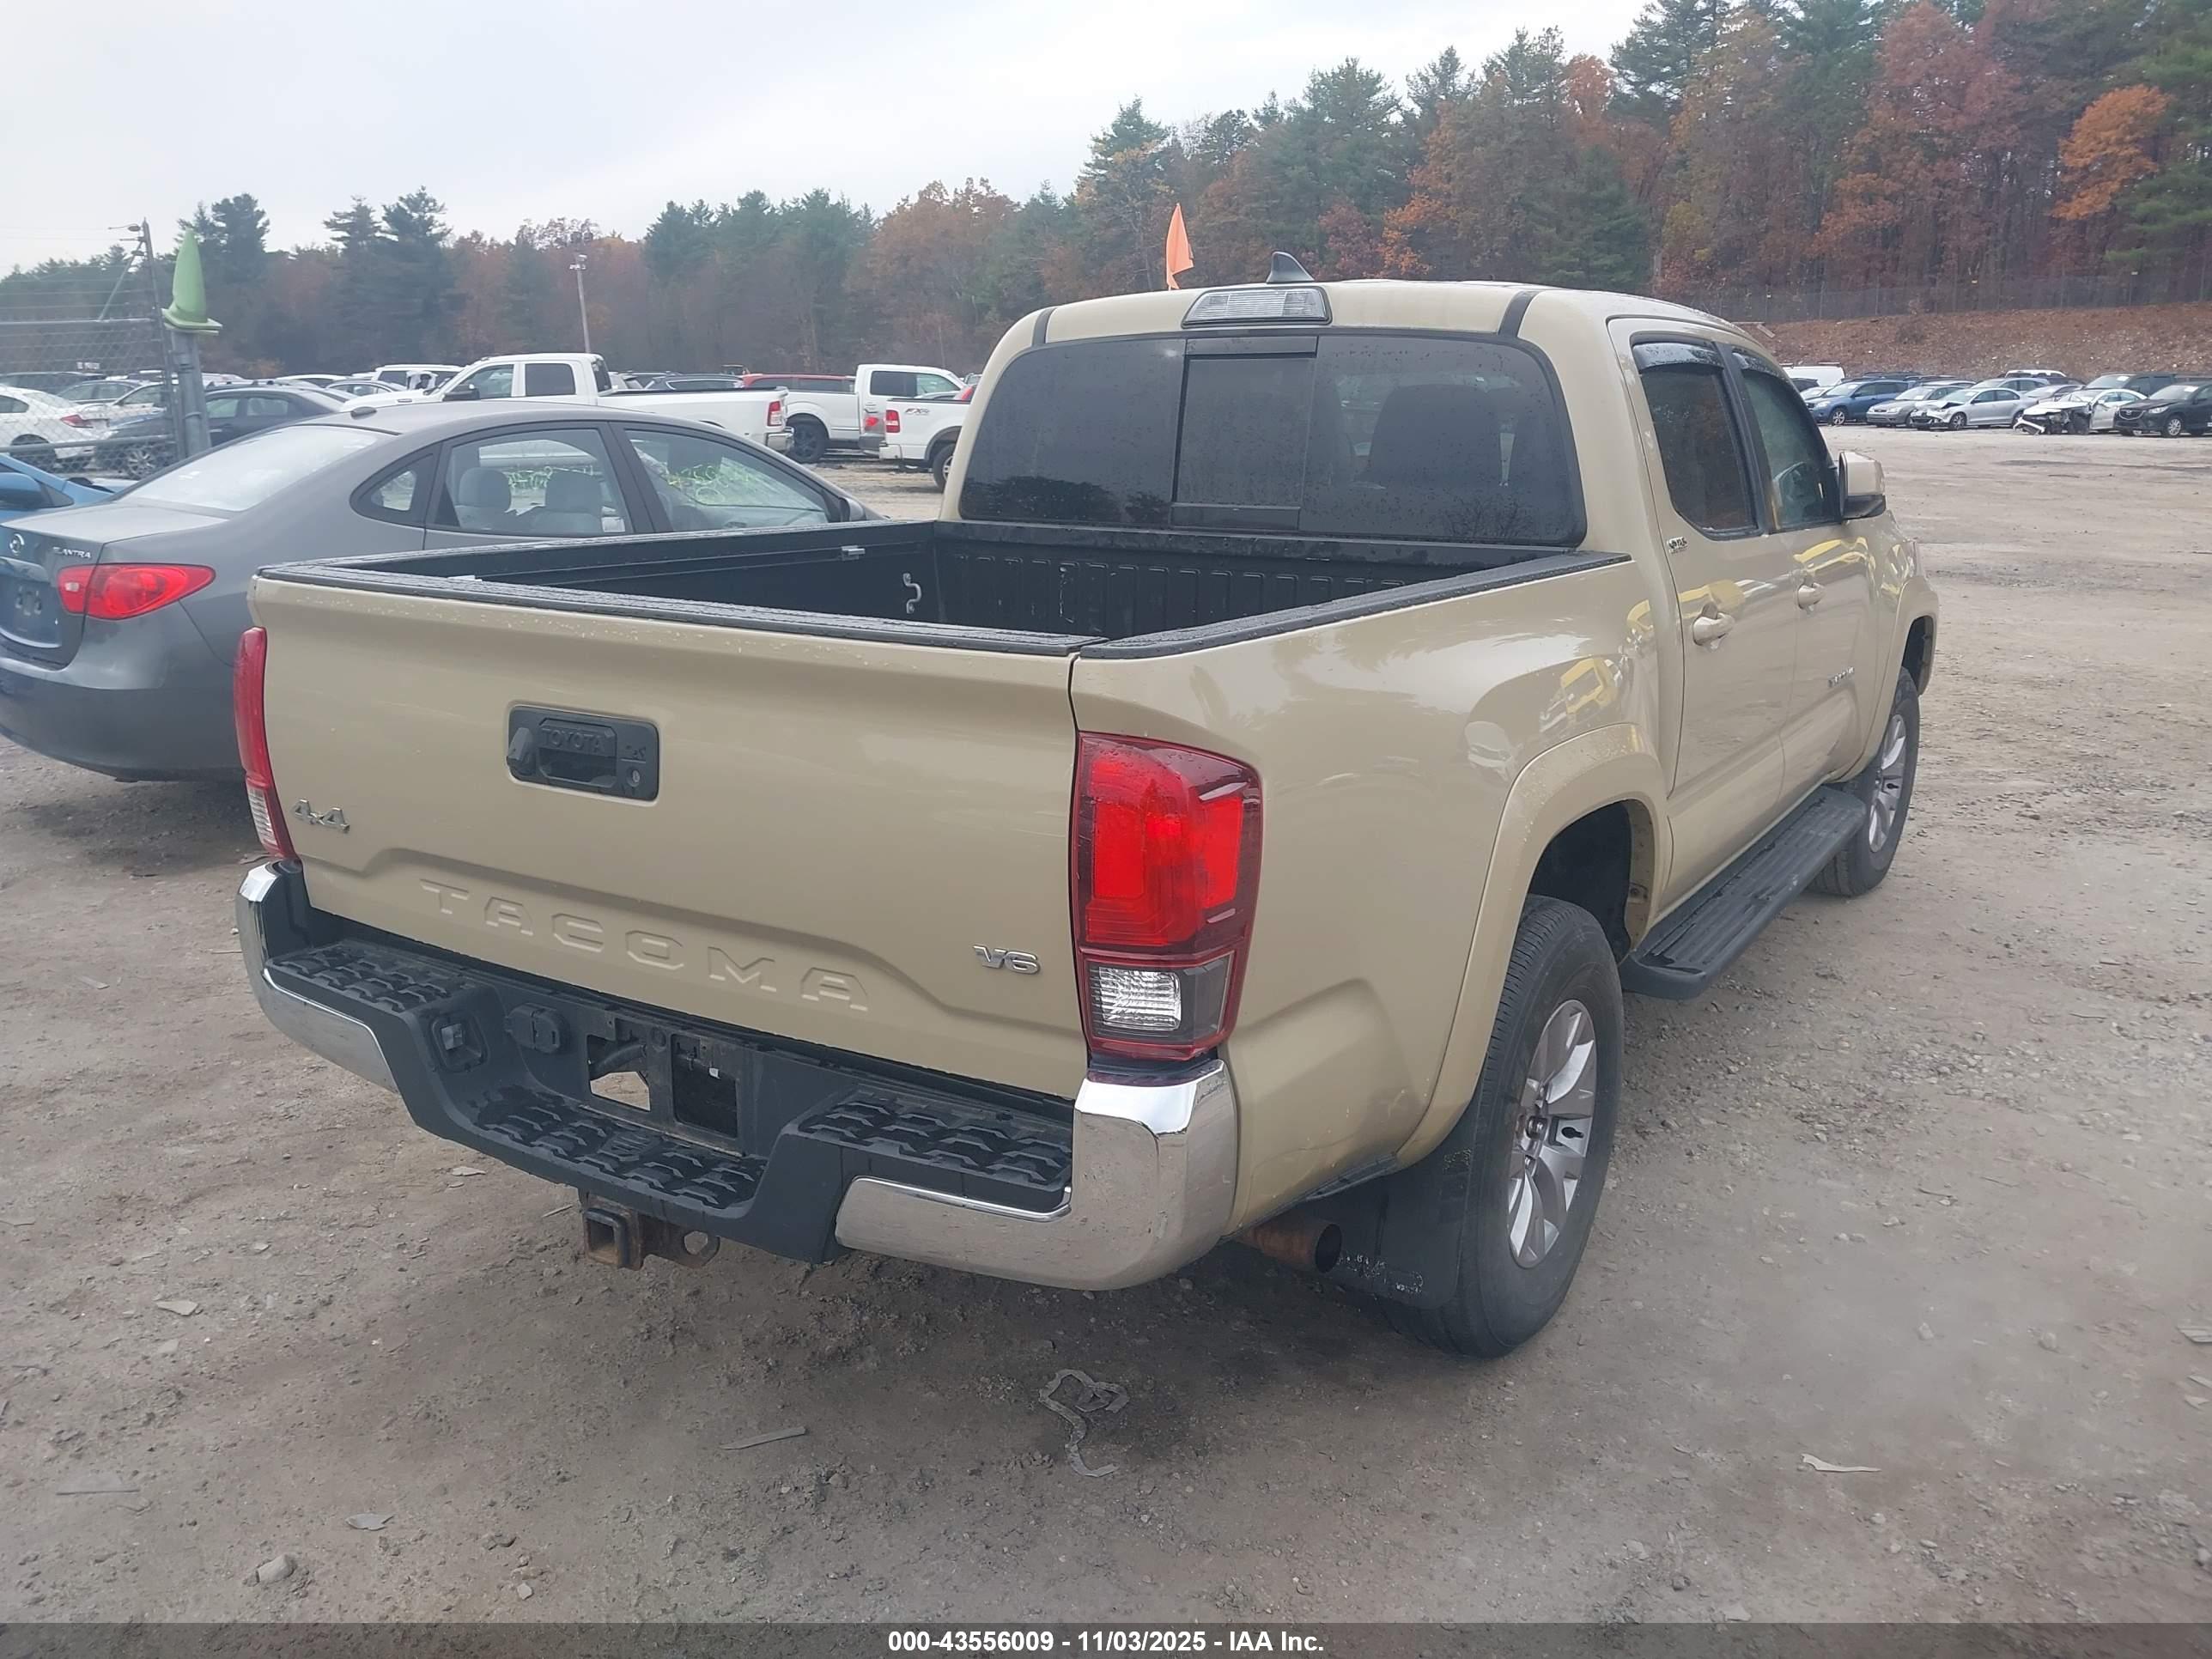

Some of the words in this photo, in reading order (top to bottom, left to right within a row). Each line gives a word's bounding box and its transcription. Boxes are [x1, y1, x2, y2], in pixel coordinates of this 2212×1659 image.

[541, 727, 605, 755] TOYOTA
[419, 878, 869, 1012] TACOMA
[972, 945, 1041, 975] V6
